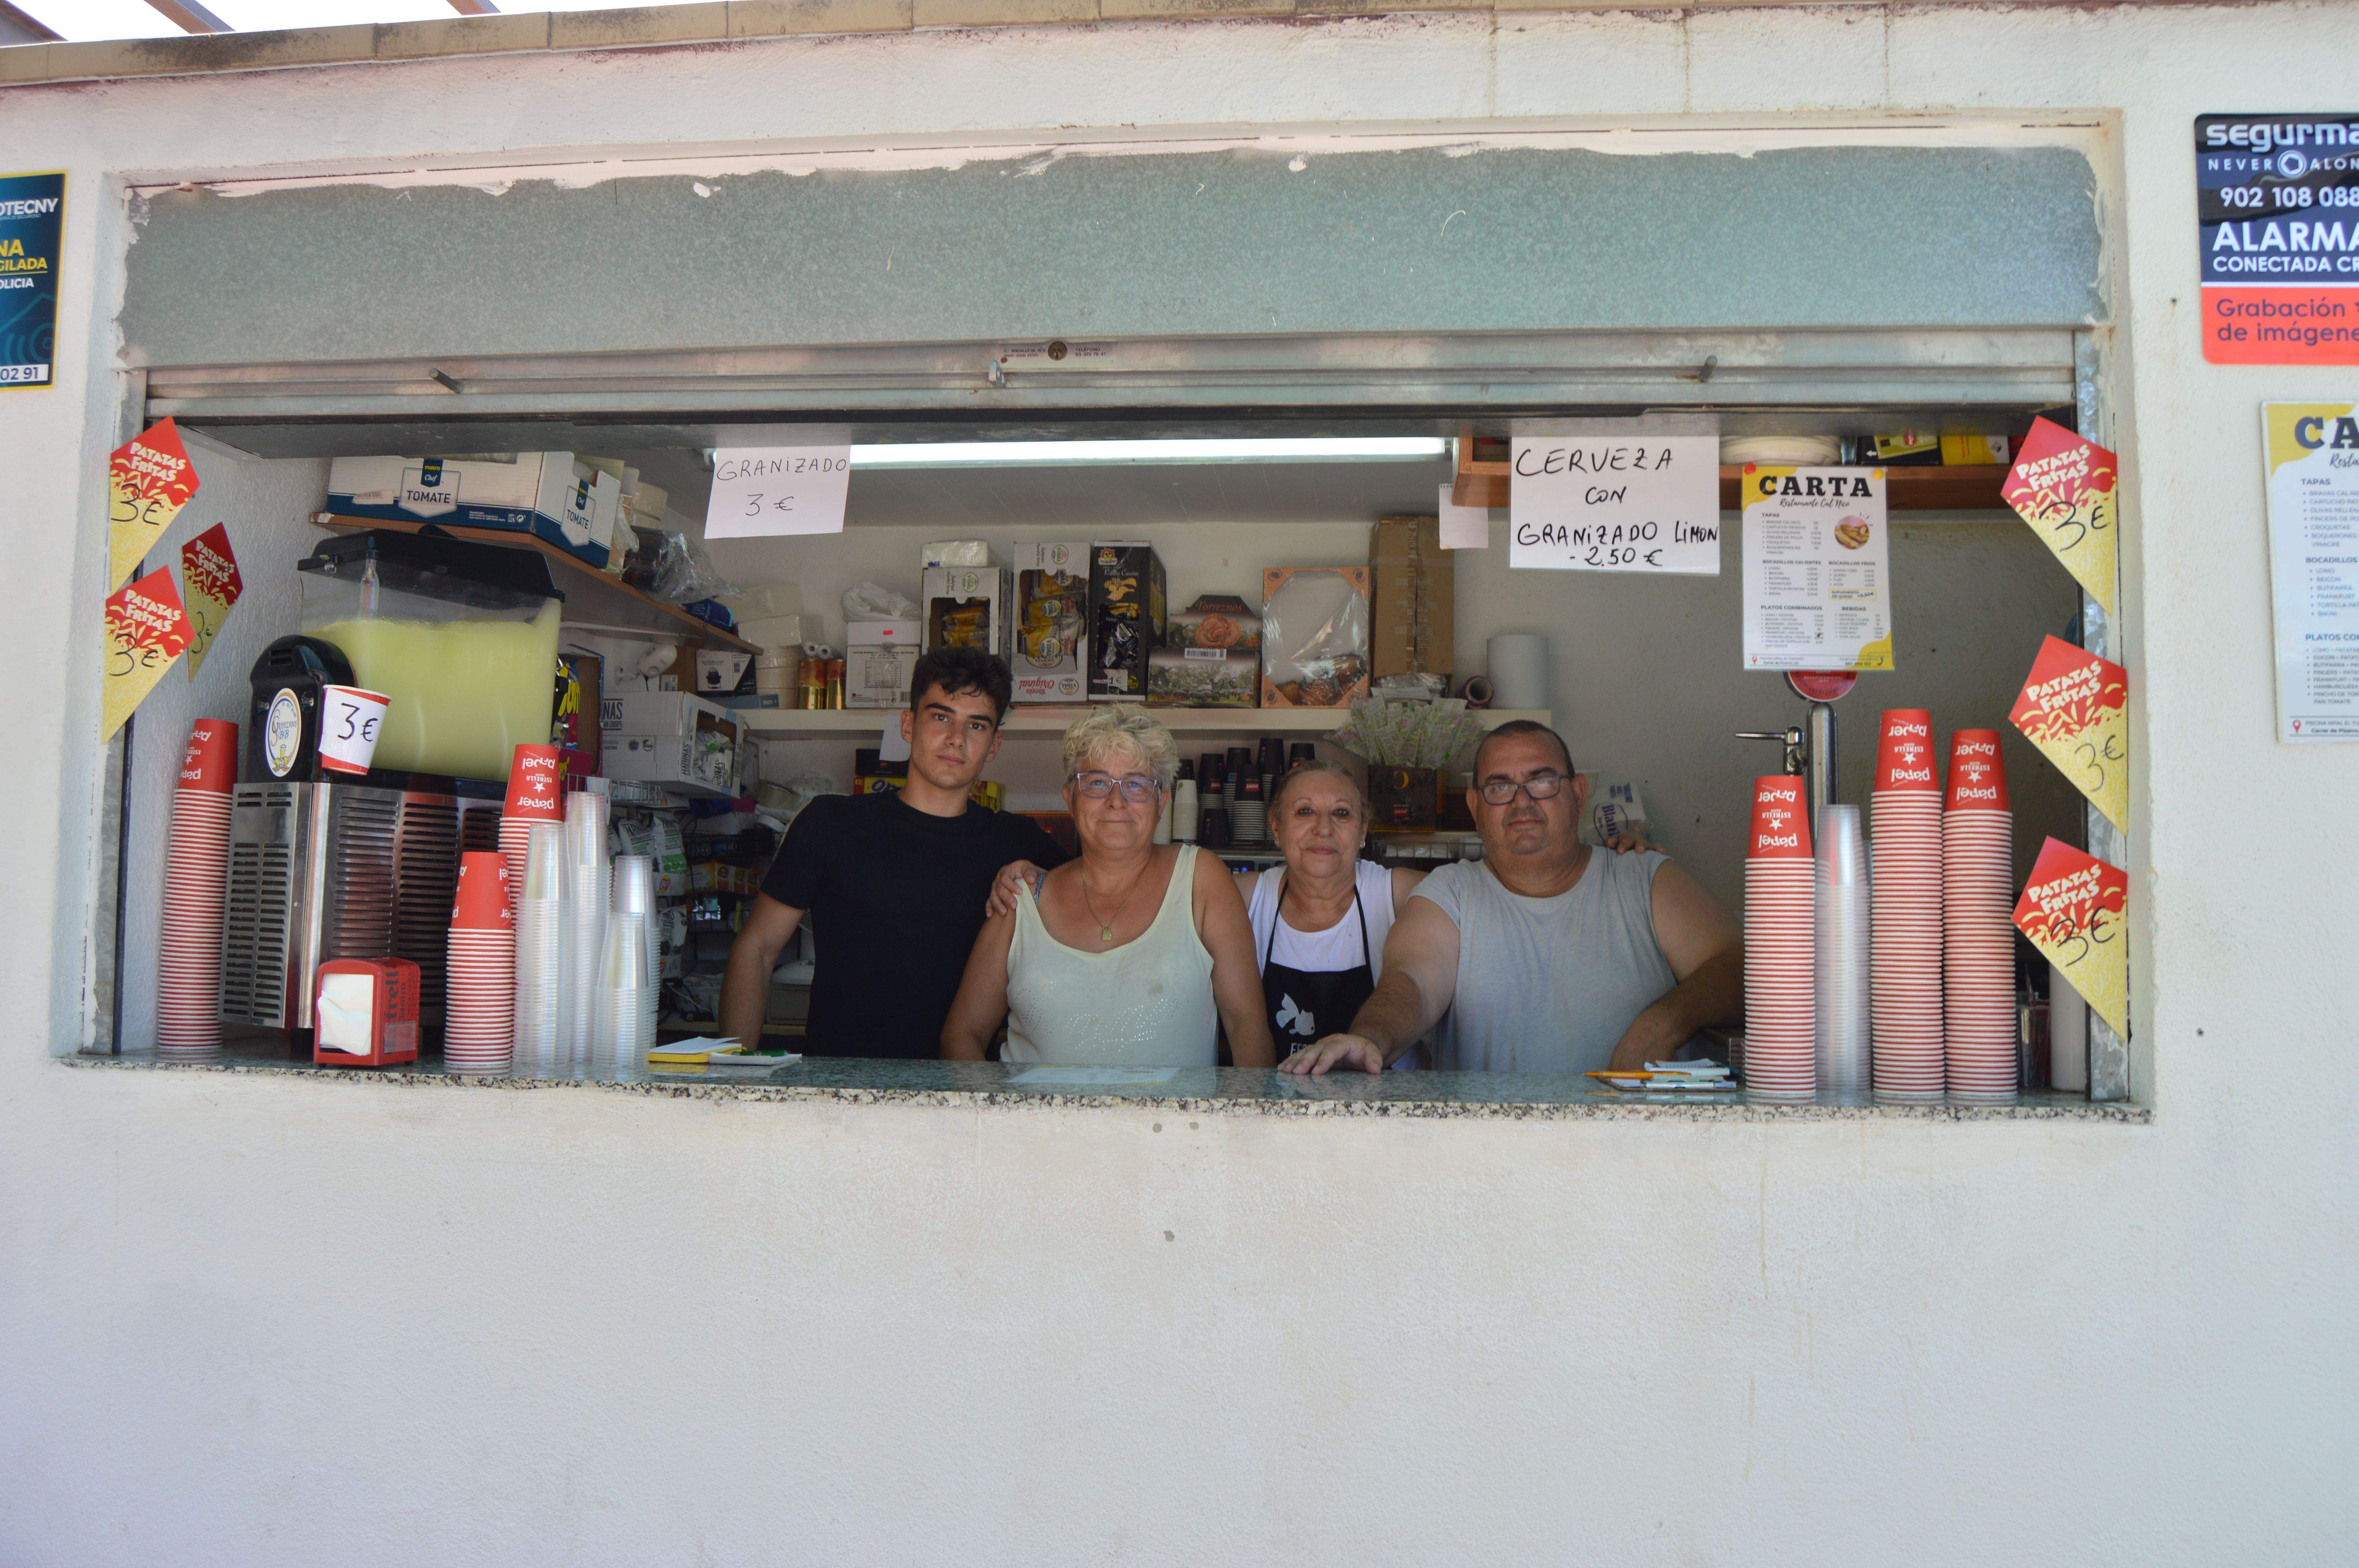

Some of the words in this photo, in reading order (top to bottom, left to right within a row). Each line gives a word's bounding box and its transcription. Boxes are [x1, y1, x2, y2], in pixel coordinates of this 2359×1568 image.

[2208, 158, 2272, 171] NEVER
[2220, 187, 2264, 207] 902
[2272, 187, 2312, 207] 108
[2319, 187, 2359, 207] 088
[2213, 256, 2332, 272] CONECTADA
[2216, 297, 2345, 317] Grabación
[2217, 323, 2248, 341] de
[0, 368, 19, 380] 02
[24, 366, 39, 380] 91
[130, 442, 186, 470] PATATAS
[1516, 448, 1673, 477] CERVEZA
[2016, 443, 2091, 479] PATATAS
[131, 459, 178, 483] FRITAS
[425, 474, 438, 482] Chef
[2029, 458, 2090, 490] FRITAS
[1585, 486, 1627, 505] CON
[1759, 475, 1872, 497] CARTA
[407, 490, 451, 504] TOMATE
[1780, 498, 1819, 508] Restaurante
[1820, 498, 1834, 508] Cal
[1835, 498, 1850, 508] Nico
[567, 509, 589, 530] TOMATE
[196, 539, 235, 574] PATATAS
[198, 553, 229, 583] FRITAS
[124, 589, 182, 622] PATATAS
[1196, 601, 1243, 612] Torreznos
[125, 605, 173, 633] FRITAS
[2305, 633, 2341, 642] PLATOS
[1019, 677, 1055, 690] Original
[2026, 660, 2102, 704] PATATAS
[2039, 677, 2102, 713] FRITAS
[1894, 745, 1924, 753] ESTRELLA
[526, 775, 552, 783] ESTRELLA
[2027, 863, 2102, 904] PATATAS
[2039, 878, 2101, 916] FRITAS
